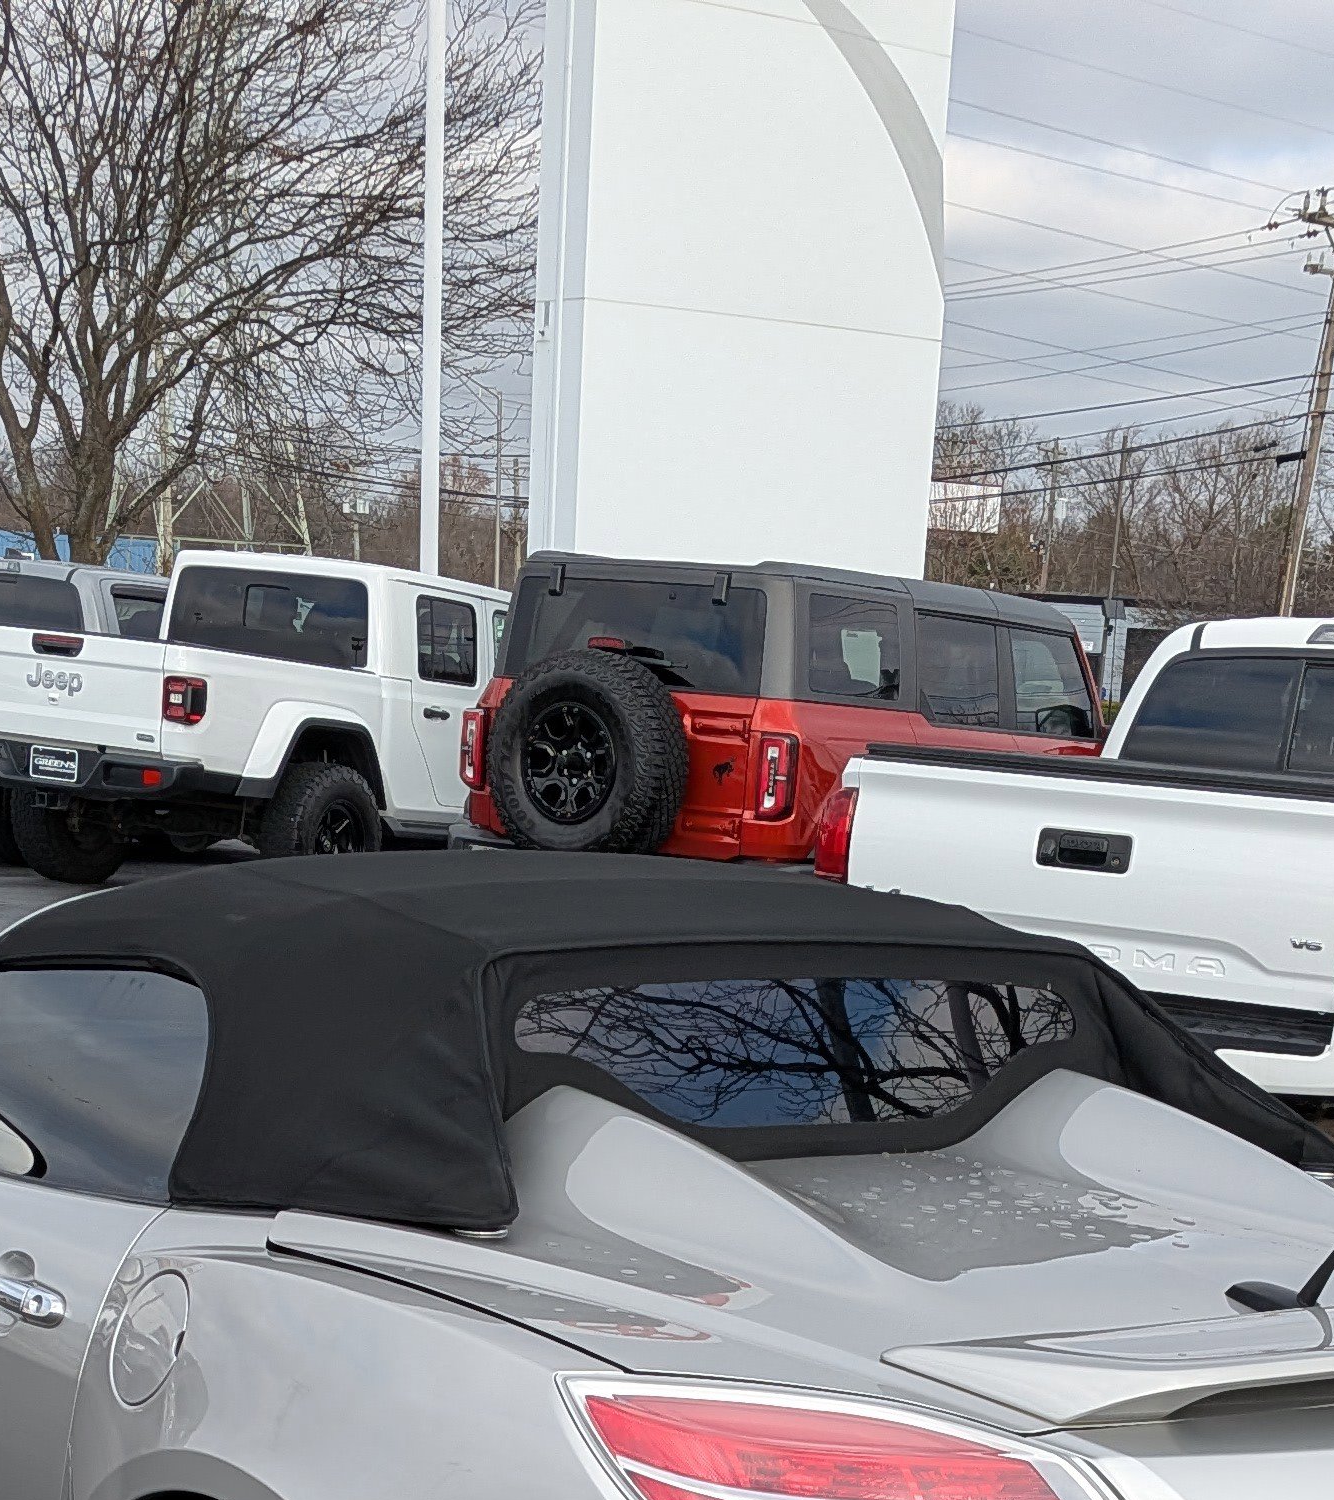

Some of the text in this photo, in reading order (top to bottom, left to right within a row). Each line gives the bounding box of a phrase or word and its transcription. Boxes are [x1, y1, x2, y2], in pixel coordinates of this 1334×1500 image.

[26, 662, 84, 697] Jeep
[1085, 942, 1227, 978] OMA
[1289, 937, 1324, 951] V6
